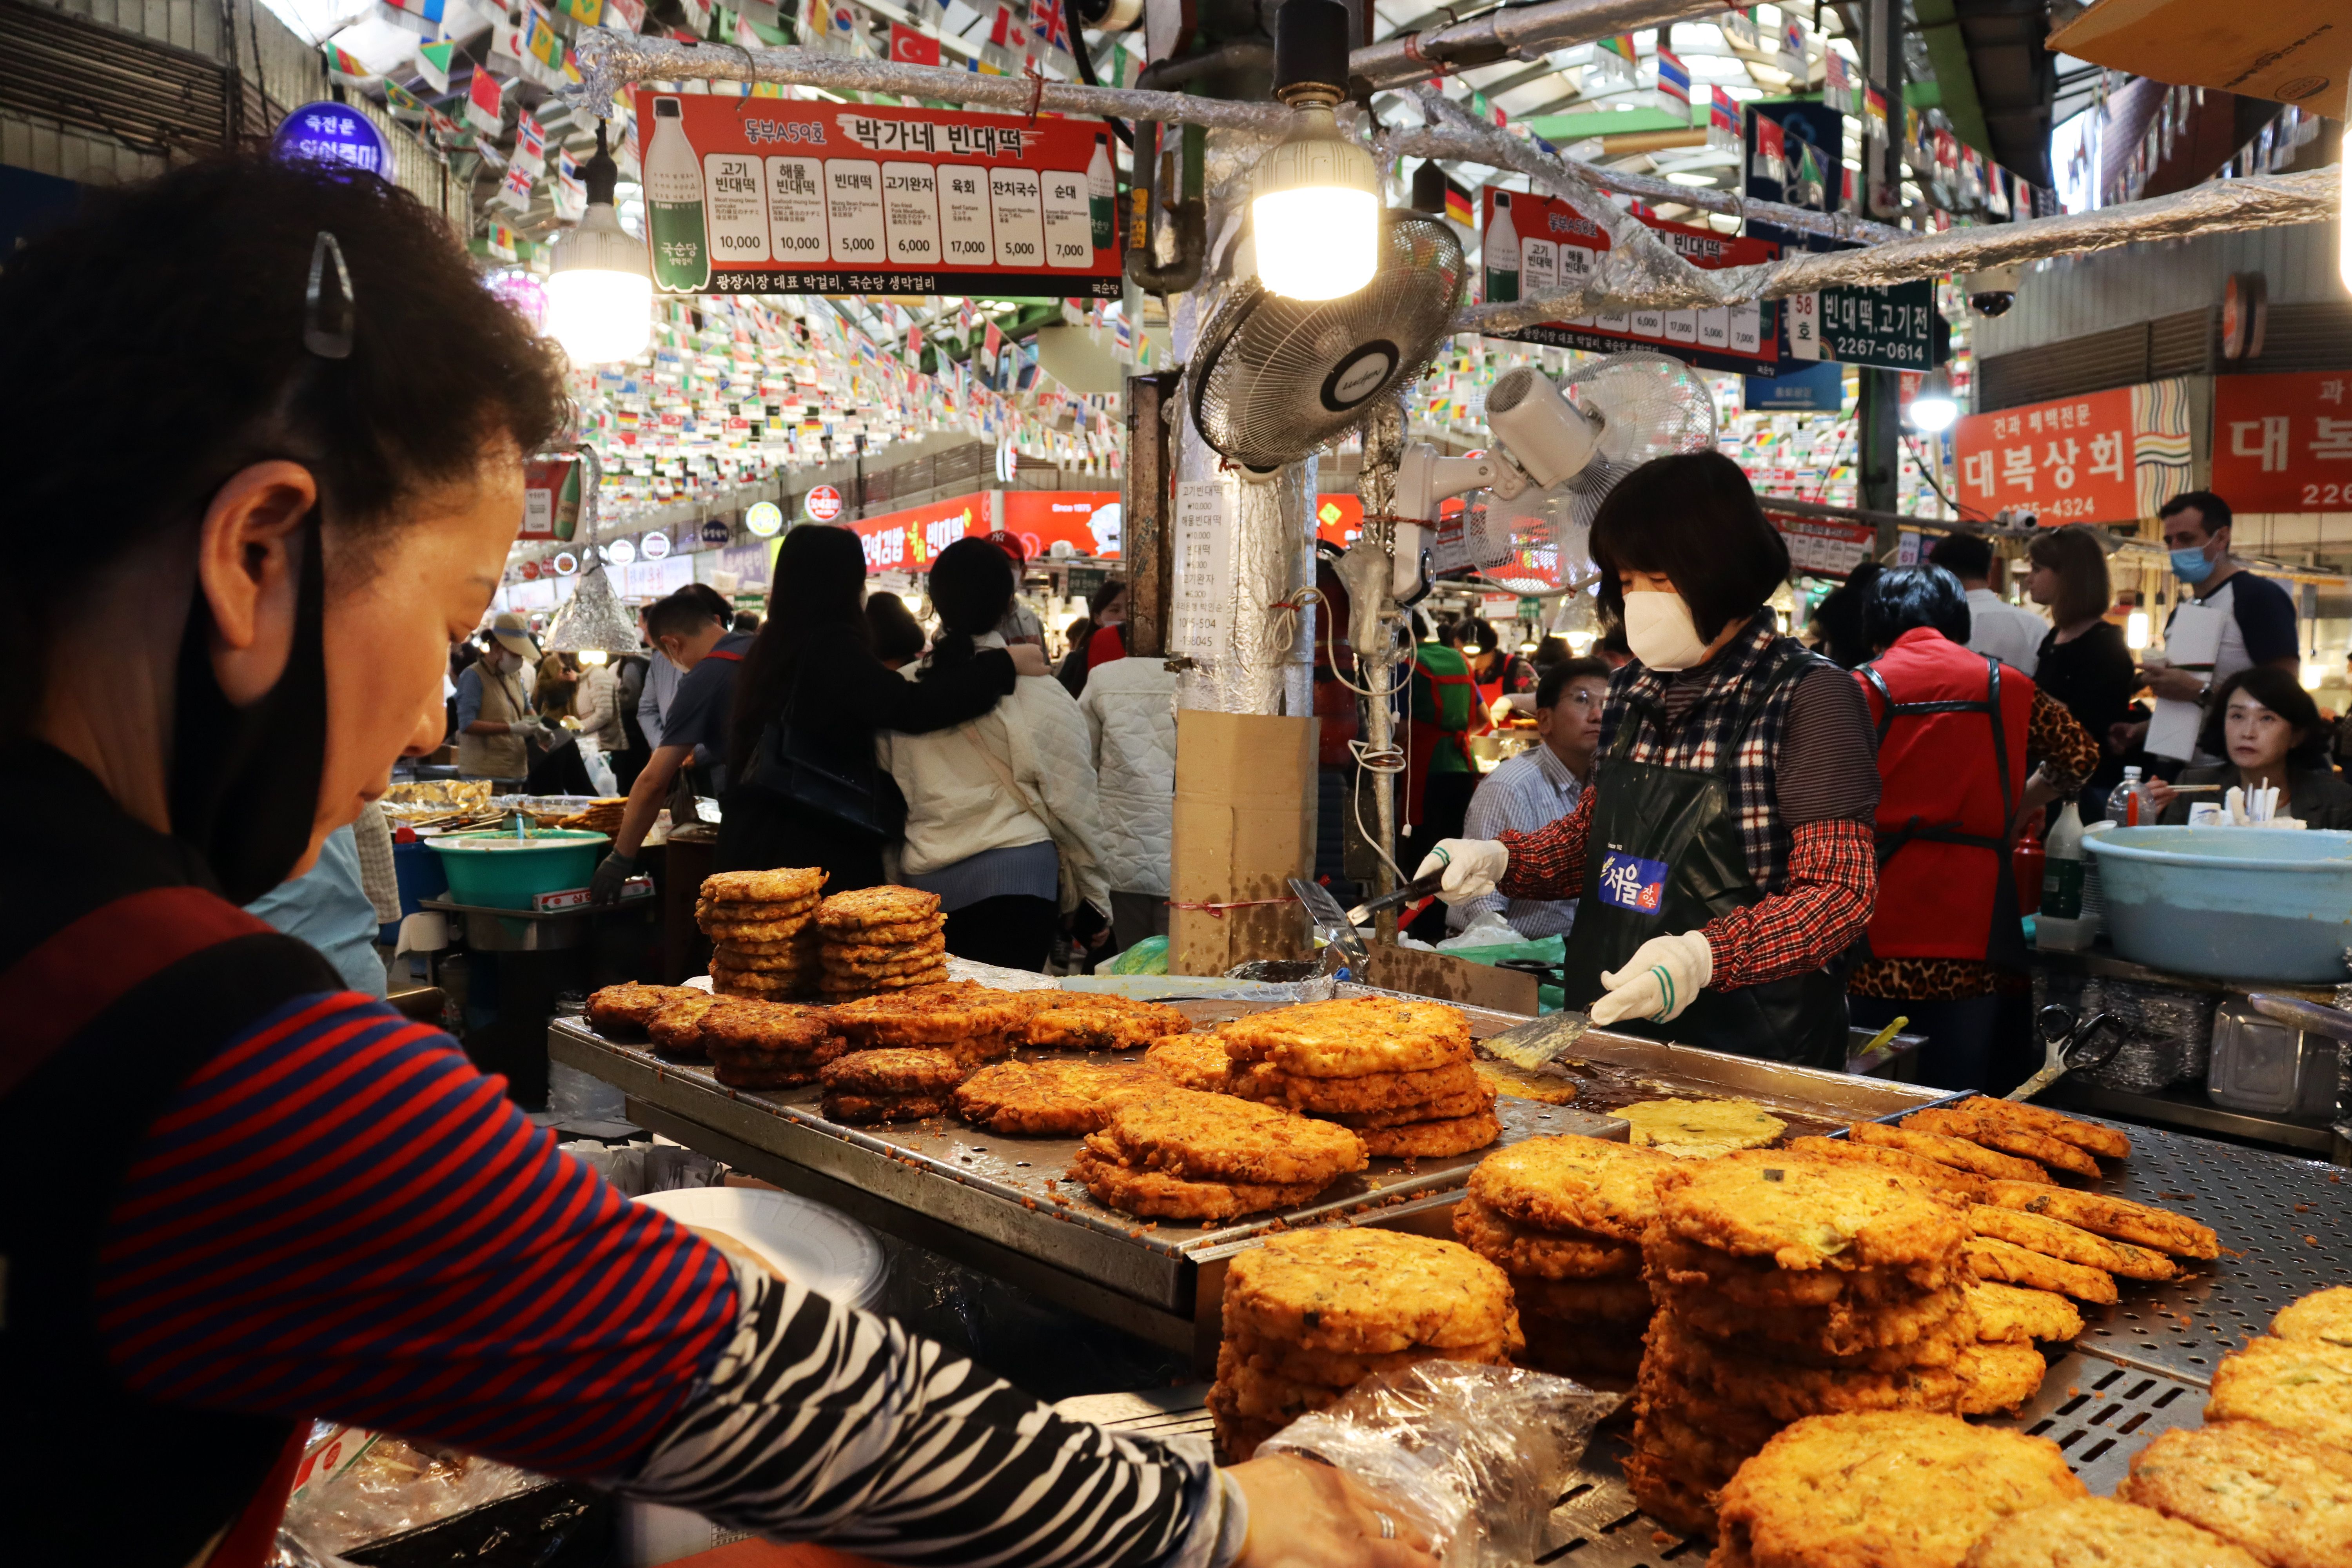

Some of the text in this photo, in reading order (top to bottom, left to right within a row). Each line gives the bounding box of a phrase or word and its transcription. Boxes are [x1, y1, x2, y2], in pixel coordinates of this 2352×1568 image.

[745, 119, 826, 145] 동부A59호
[855, 119, 1022, 158] 박가네 빈대떡
[722, 162, 747, 177] 고기
[780, 163, 805, 180] 해물
[716, 177, 755, 193] 빈대떡
[777, 179, 815, 195] 빈대떡
[835, 174, 872, 189] 빈대떡
[886, 176, 933, 191] 고기완자
[952, 179, 975, 194] 육회
[993, 181, 1038, 197] 잔치국수
[1055, 185, 1076, 199] 순대
[1549, 213, 1598, 238] 동부A58호
[661, 241, 698, 257] 국순당
[720, 236, 760, 250] 10,000
[780, 237, 820, 252] 10,000
[843, 238, 874, 252] 5,000
[898, 240, 929, 253] 6,000
[951, 241, 985, 254] 17,000
[1005, 242, 1034, 256] 5,000
[1532, 244, 1548, 257] 고기
[1674, 234, 1720, 263] 빈대떡
[1056, 245, 1083, 258] 7,000
[1528, 255, 1552, 269] 빈대떡
[717, 275, 935, 291] 광장시장 대표 막걸리, 국순당 생막걸리
[1092, 283, 1118, 295] 국순당
[1796, 293, 1812, 315] 58
[1638, 316, 1658, 327] 6,000
[1670, 321, 1692, 333] 17,000
[1704, 327, 1723, 338] 5,000
[1737, 332, 1754, 344] 7,000
[1798, 321, 1812, 341] 호
[1558, 335, 1574, 344] 대표
[1605, 339, 1627, 351] 국순당
[1837, 336, 1924, 362] 2267-0614
[1964, 430, 2125, 498] 대복상회
[1183, 485, 1223, 497] 고기빈대떡
[1052, 503, 1091, 512] Since 1975
[1181, 515, 1221, 526] 해물빈대떡
[1187, 544, 1210, 555] 빈대떡
[1184, 574, 1215, 585] 고기완자
[1604, 864, 1642, 906] 서울
[1642, 884, 1657, 908] 장수
